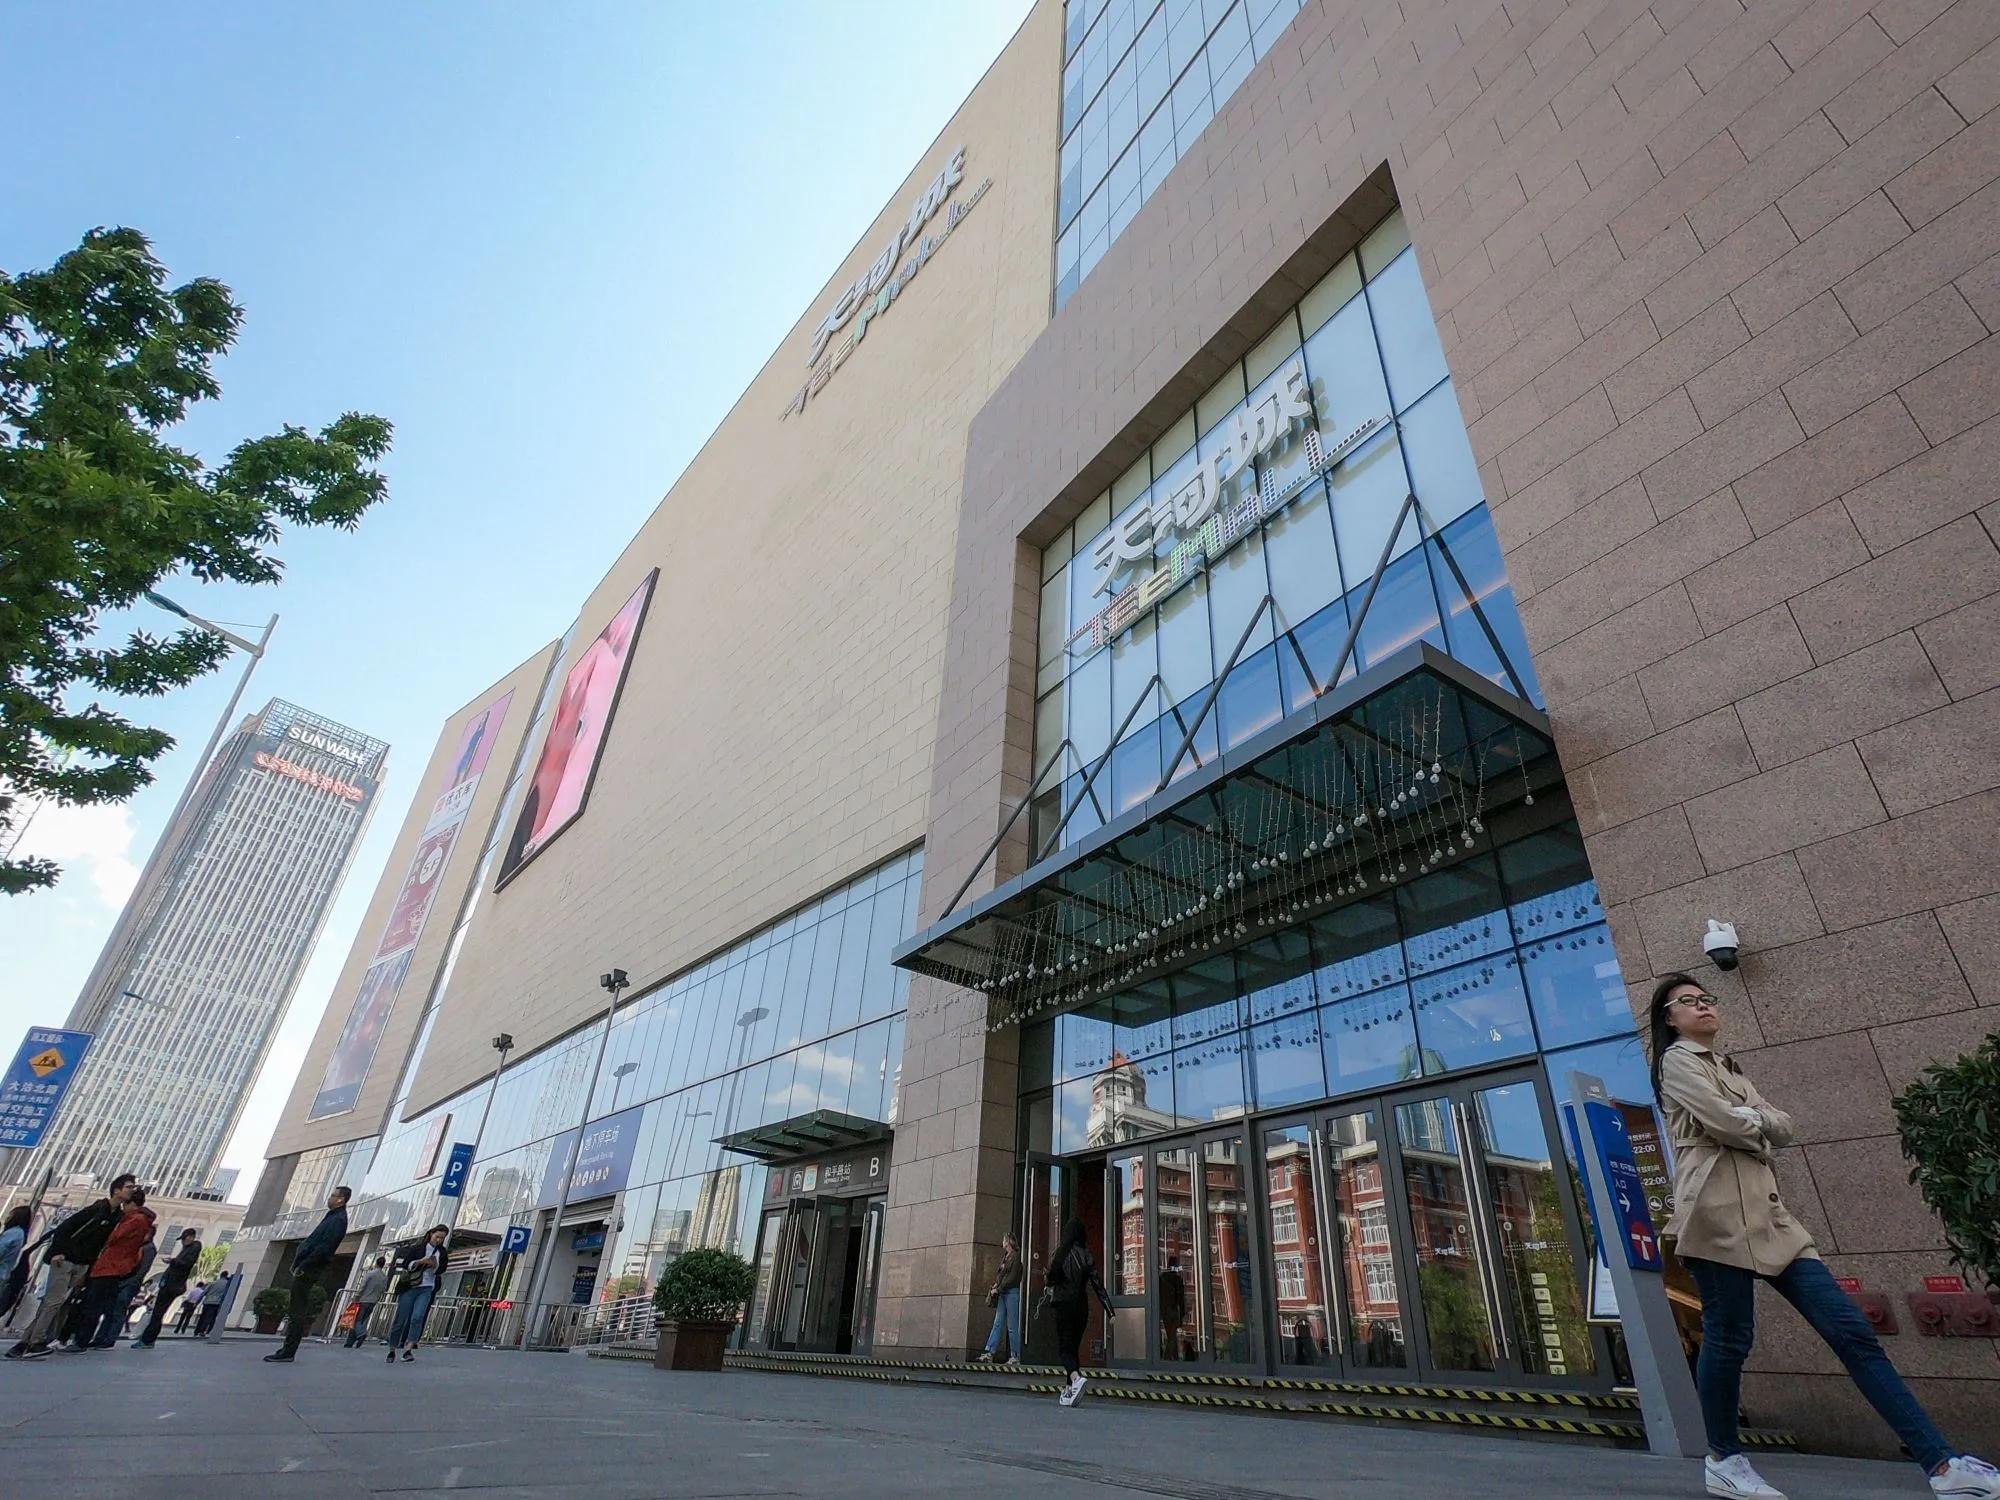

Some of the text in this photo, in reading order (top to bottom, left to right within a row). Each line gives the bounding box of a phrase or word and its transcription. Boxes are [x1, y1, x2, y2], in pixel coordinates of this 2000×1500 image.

[806, 143, 967, 370] 天河城
[1092, 359, 1312, 600] 天河城
[1063, 416, 1386, 650] TEEMALL
[288, 726, 365, 764] SUNWAH
[450, 1161, 463, 1177] P
[869, 1157, 880, 1177] B
[1615, 1179, 1628, 1191] 入口
[508, 1229, 525, 1249] P
